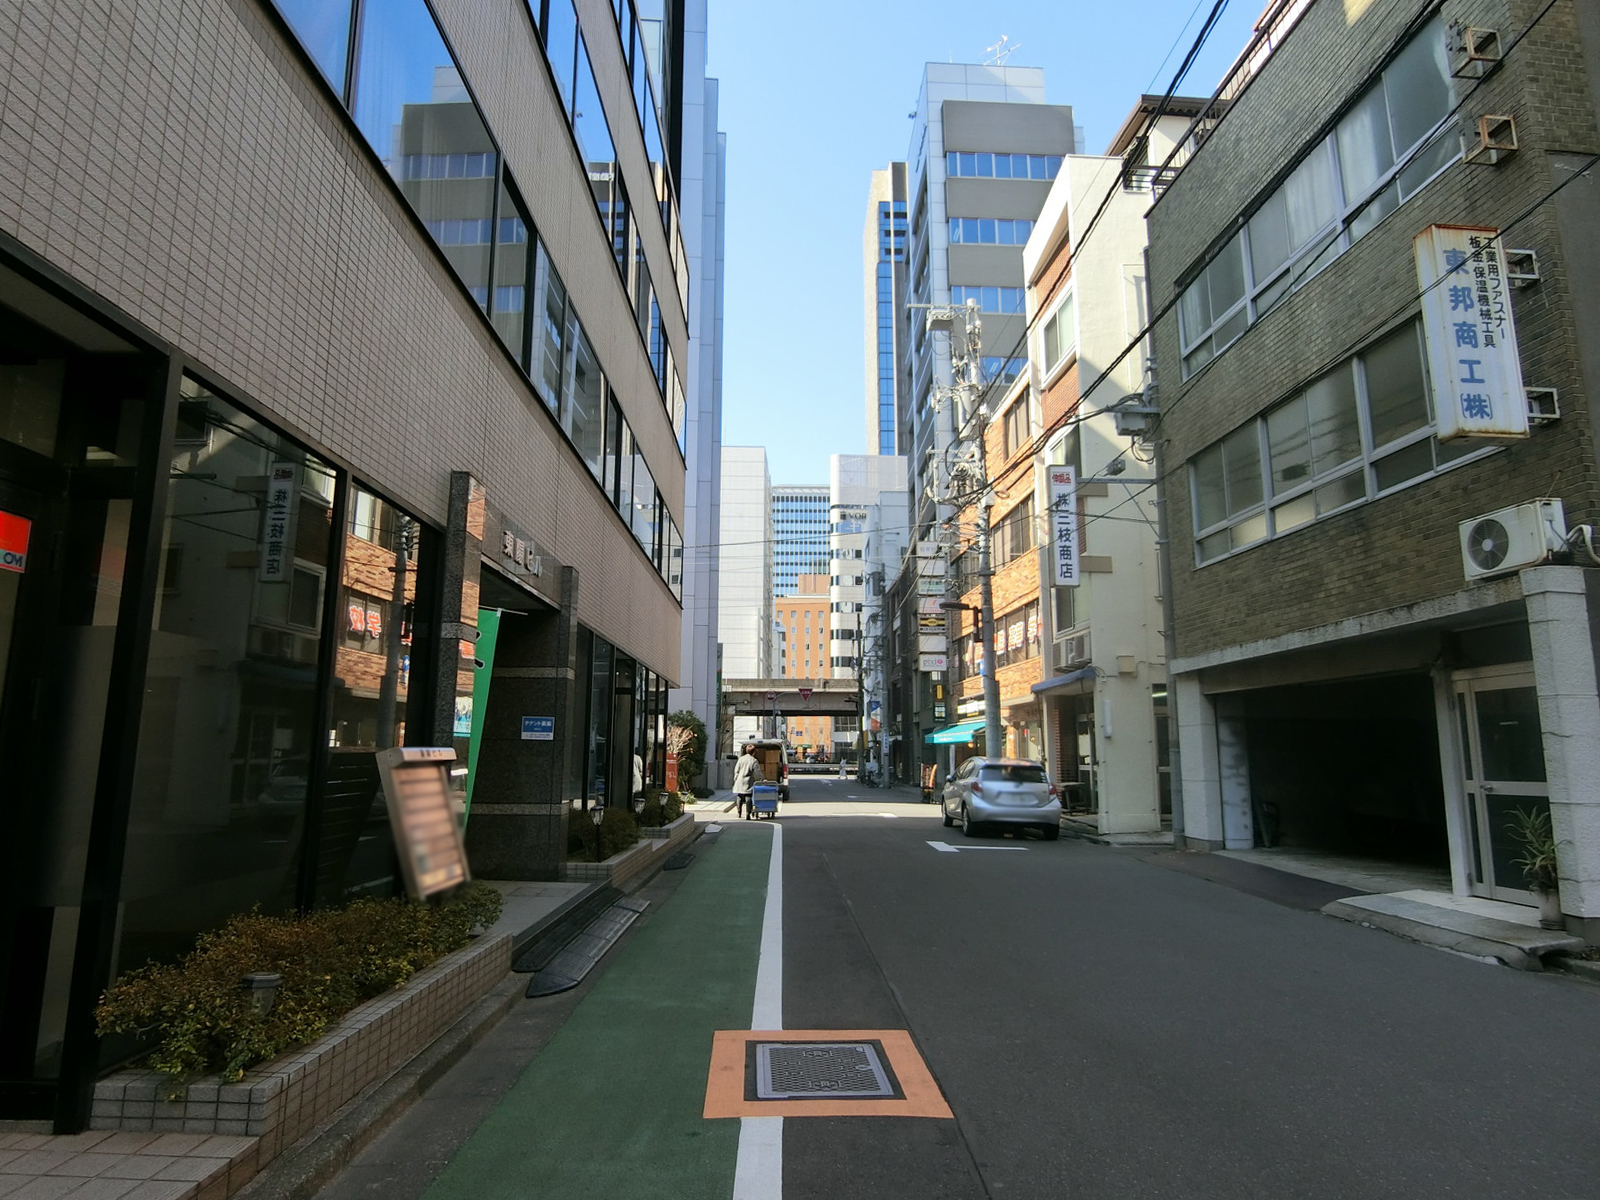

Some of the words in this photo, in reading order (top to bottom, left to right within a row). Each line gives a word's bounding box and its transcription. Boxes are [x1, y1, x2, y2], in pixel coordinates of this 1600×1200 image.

[1483, 236, 1507, 340] 工業用ファスナー
